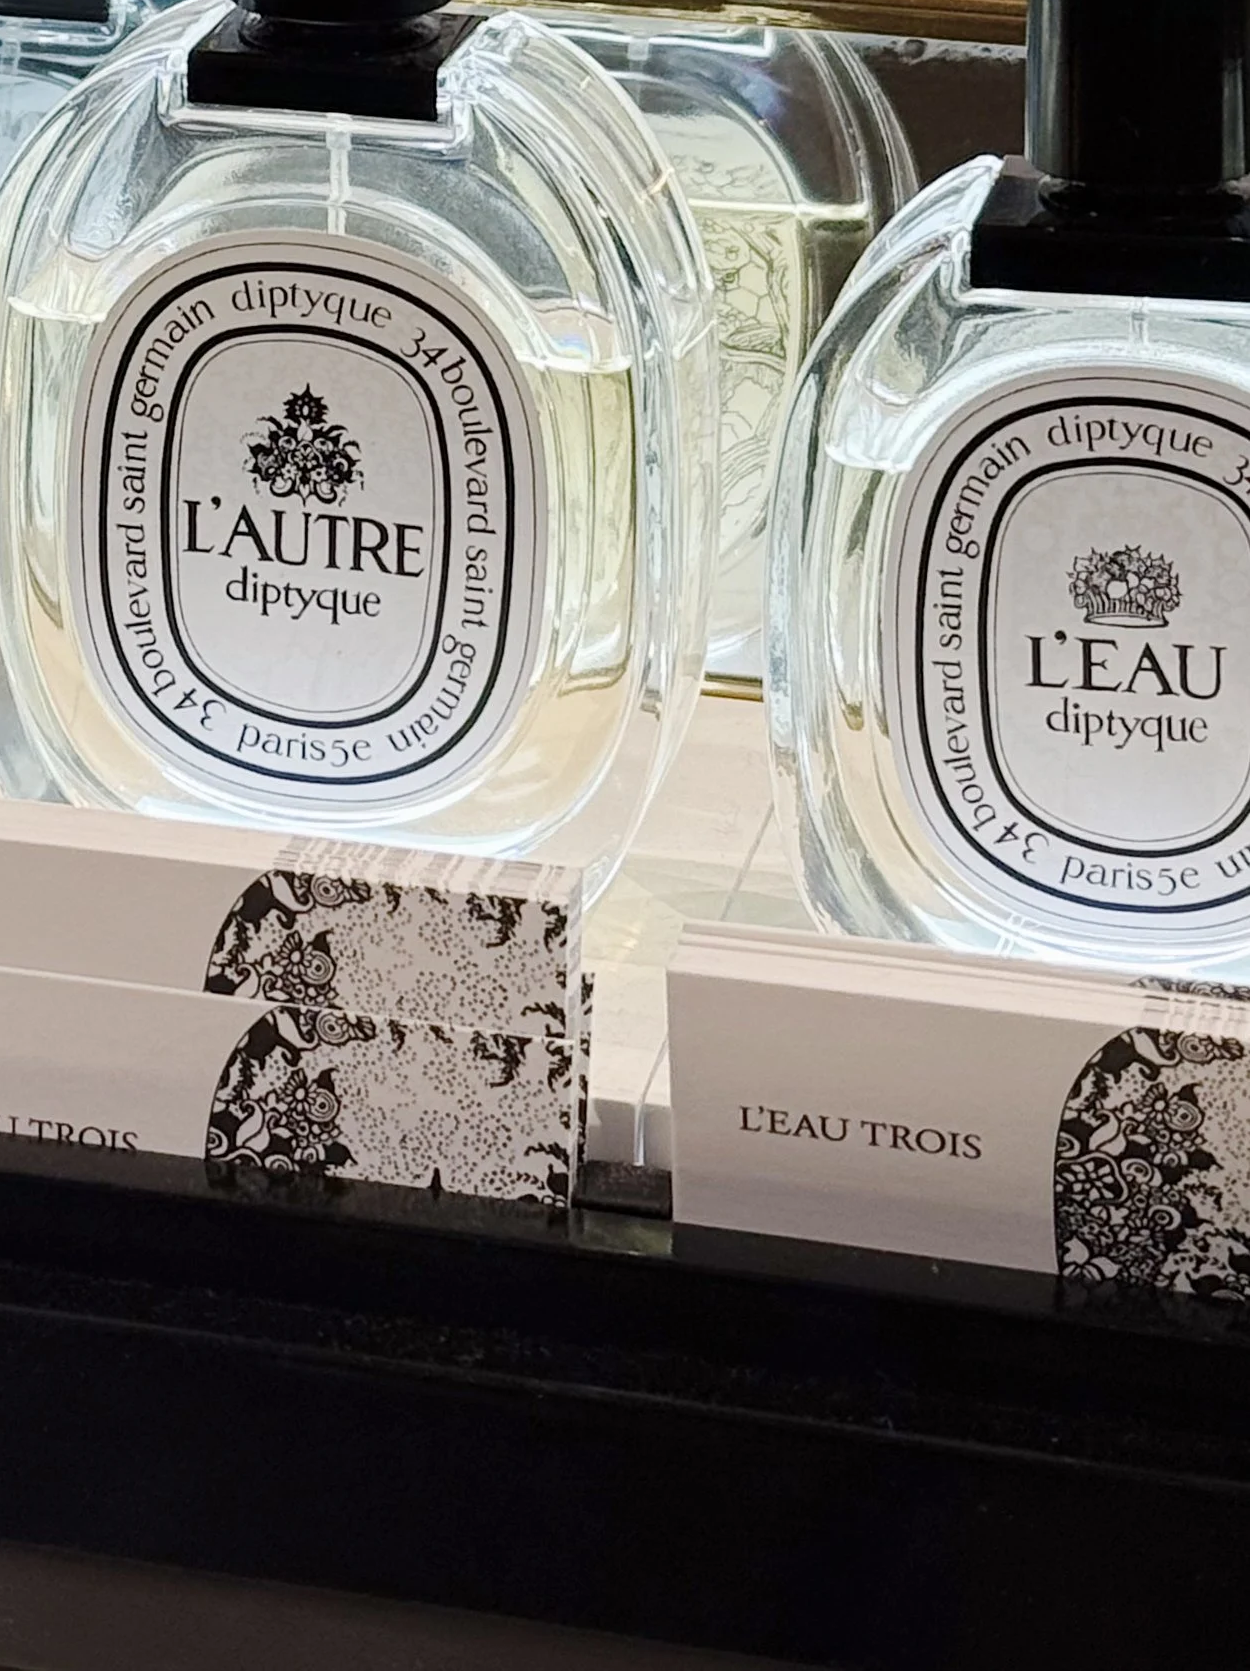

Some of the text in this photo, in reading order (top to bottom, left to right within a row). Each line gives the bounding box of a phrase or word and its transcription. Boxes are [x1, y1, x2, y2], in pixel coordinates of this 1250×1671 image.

[1045, 413, 1215, 461] diptyque
[114, 279, 497, 753] 34 boulevard saint germain diptyque 34 boulevard saint germain
[943, 434, 1033, 560] germain
[182, 495, 428, 580] L'AUTRE
[225, 565, 383, 626] diptyque
[930, 566, 965, 652] saint
[1024, 630, 1229, 701] L'EAU
[929, 659, 999, 833] boulevard
[1045, 697, 1209, 753] diptyque
[993, 819, 1052, 866] 34
[739, 1104, 984, 1161] L'EAU TROIS
